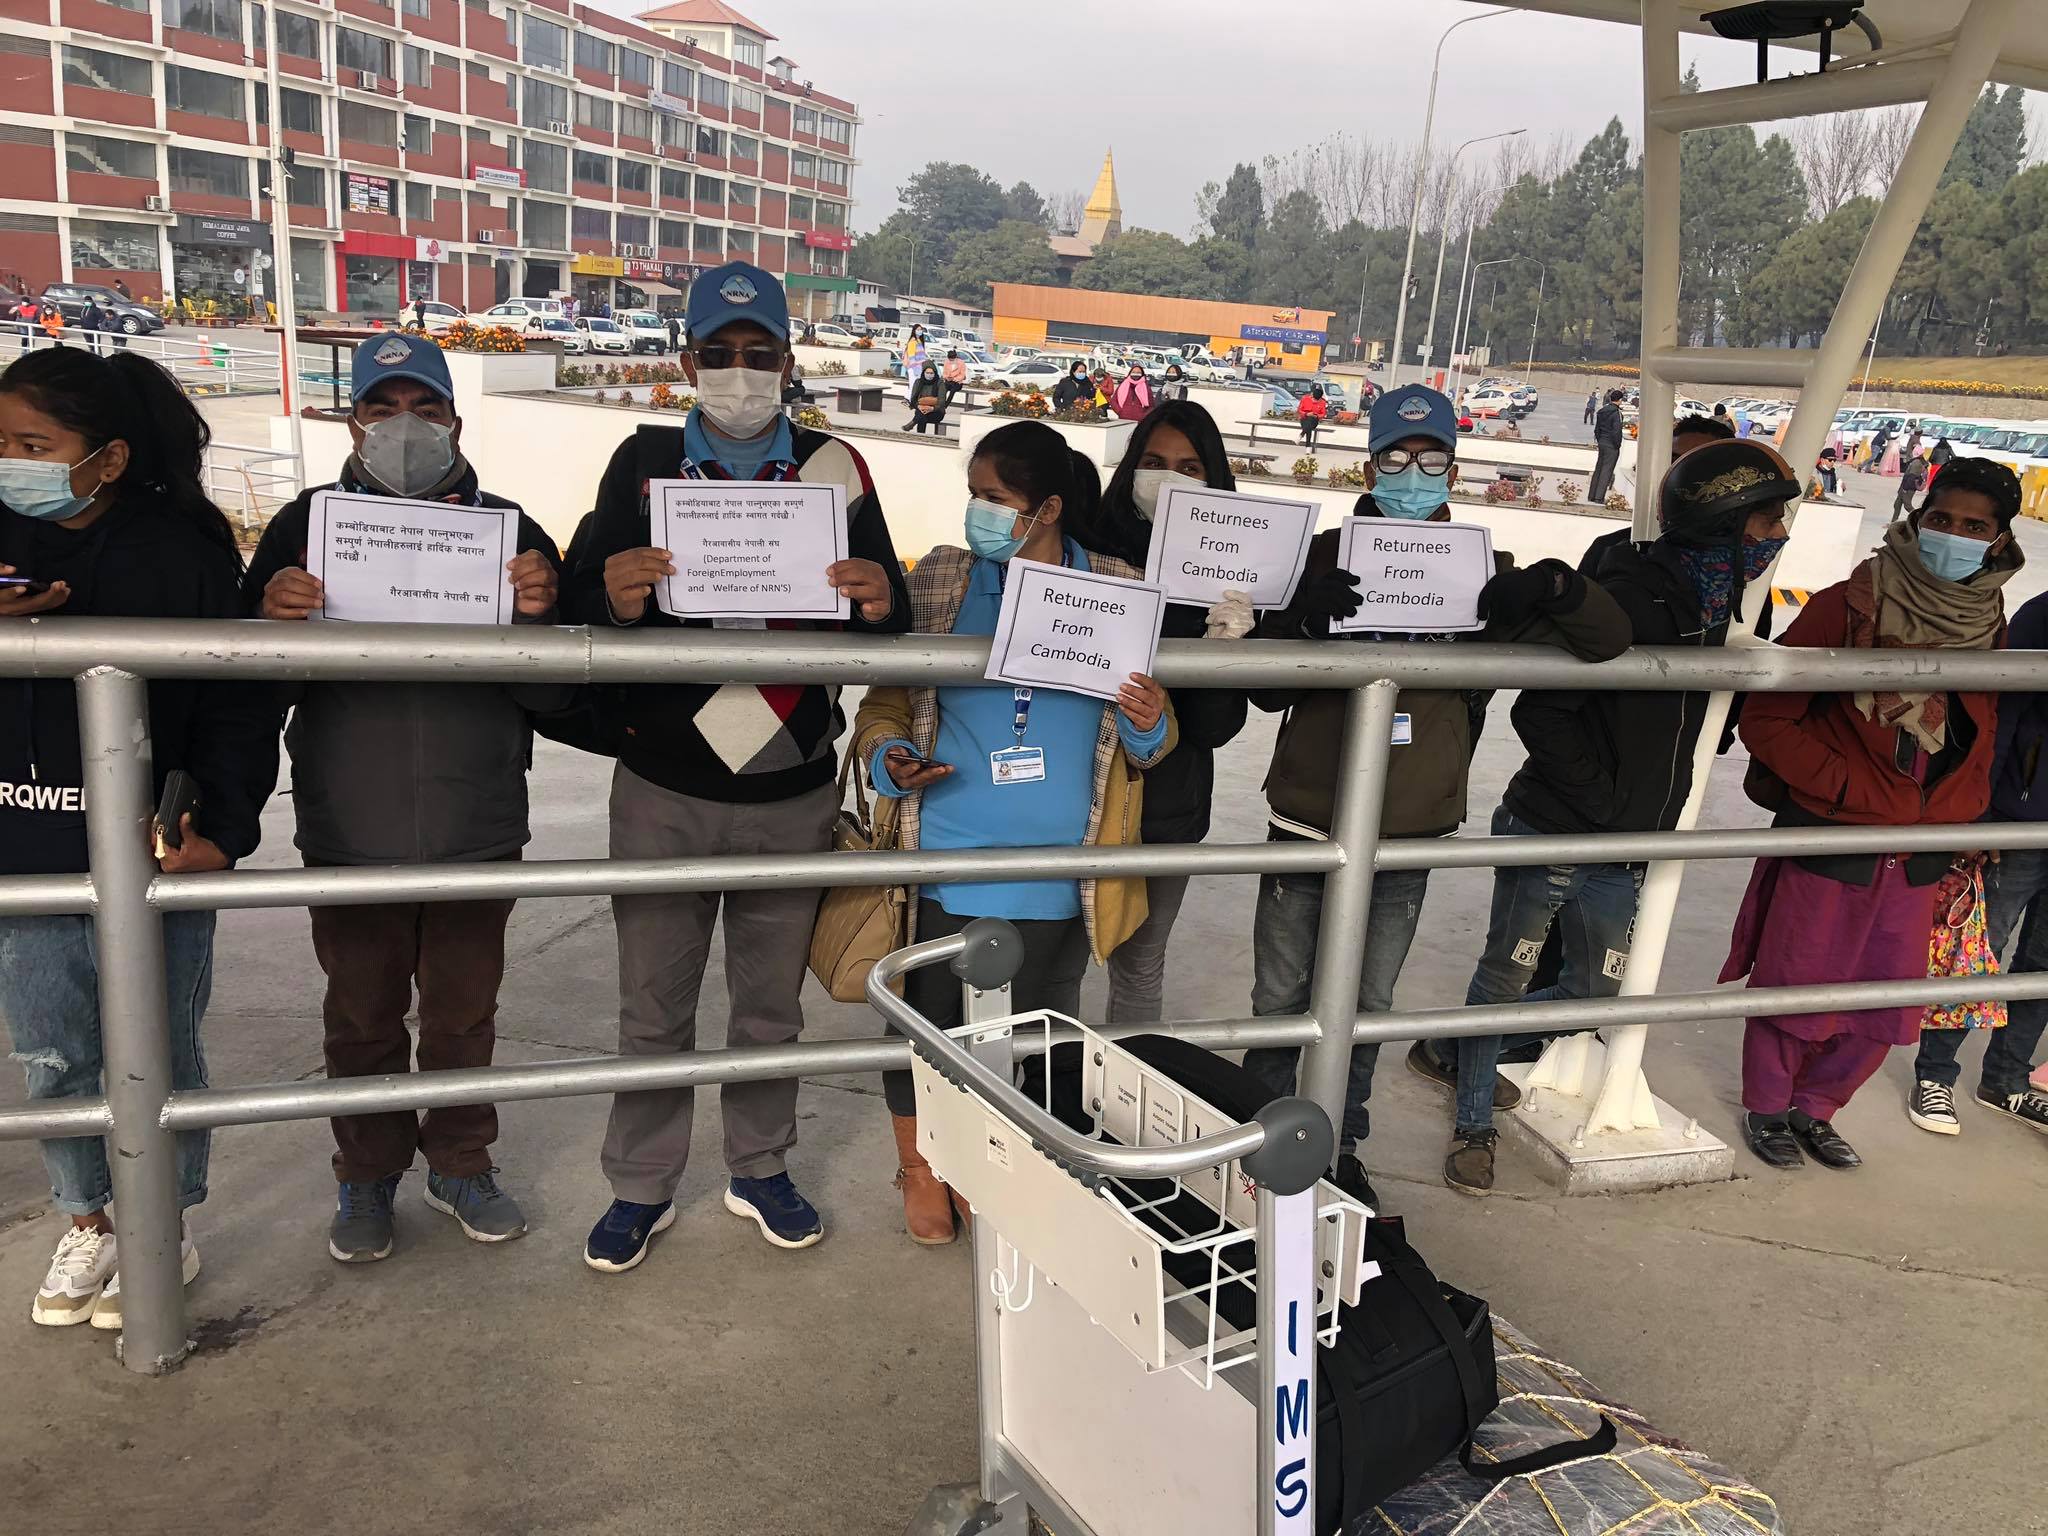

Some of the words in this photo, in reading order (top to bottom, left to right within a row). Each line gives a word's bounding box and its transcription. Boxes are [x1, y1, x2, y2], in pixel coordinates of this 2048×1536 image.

[202, 221, 235, 231] HIMALAYAN
[236, 225, 250, 233] JAVA
[216, 231, 237, 239] COFFEE
[631, 260, 639, 270] T3
[640, 261, 663, 272] THAKALI
[727, 290, 750, 299] NRNA
[1245, 328, 1282, 338] AIRPORT
[1285, 331, 1303, 339] CAR
[380, 351, 405, 361] NRNA
[1404, 409, 1426, 417] NRNA
[724, 498, 743, 507] नेपाल
[722, 510, 743, 520] हार्दिक
[745, 511, 768, 520] स्वागत
[1189, 506, 1270, 531] Returnees
[335, 521, 396, 535] कम्बोडियाबाट
[400, 524, 424, 537] नेपाल
[428, 528, 474, 541] पाल्नुभएका
[335, 536, 363, 549] सम्पुर्ण
[426, 542, 453, 554] हार्दिक
[457, 546, 486, 557] स्वागत
[702, 537, 741, 548] गैरआवासीय
[744, 538, 765, 548] नेपाली
[768, 538, 780, 548] संघ
[1199, 536, 1240, 555] From
[1373, 538, 1451, 554] Returnees
[703, 553, 760, 566] (Department
[762, 553, 771, 563] of
[687, 568, 776, 580] ForeignEmployment
[1181, 560, 1259, 584] Cambodia
[1384, 565, 1425, 580] From
[389, 586, 439, 600] गैरआवासीय
[443, 589, 471, 602] नेपाली
[474, 593, 490, 604] संघ
[687, 584, 705, 593] and
[712, 583, 748, 593] Welfare
[749, 583, 760, 593] of
[761, 584, 792, 594] NRN'S)
[1043, 587, 1127, 617] Returnees
[1366, 590, 1445, 606] Cambodia
[1051, 618, 1094, 638] From
[1030, 643, 1112, 670] Cambodia
[0, 781, 86, 811] RQWE
